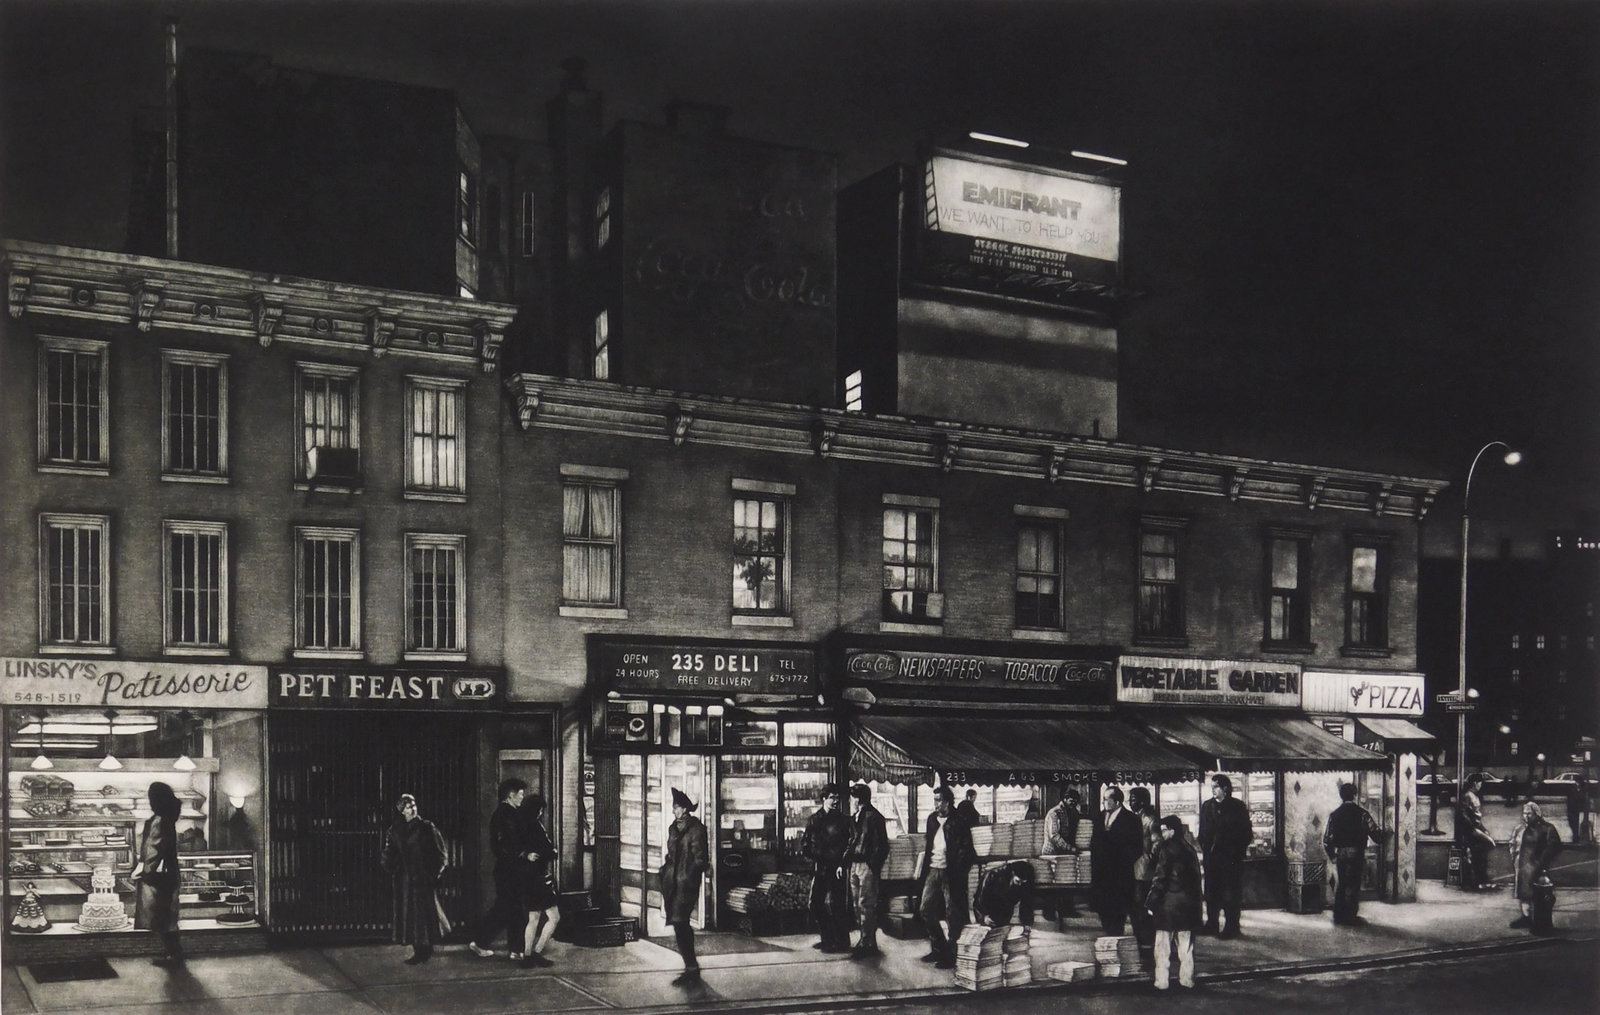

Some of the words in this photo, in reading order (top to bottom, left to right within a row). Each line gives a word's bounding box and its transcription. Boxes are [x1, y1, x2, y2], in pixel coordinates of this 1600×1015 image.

[962, 181, 1082, 220] EMIGRANT
[939, 206, 964, 223] WE
[967, 210, 1007, 234] WANT
[1015, 217, 1032, 235] TO
[1039, 223, 1074, 241] HELP
[623, 653, 649, 665] OPEN
[671, 653, 704, 671] 235
[714, 654, 760, 673] DELI
[779, 659, 796, 670] TEL
[5, 660, 97, 681] LINSKY'S
[615, 668, 626, 678] 24
[629, 669, 660, 679] HOURS
[769, 674, 809, 683] 675-1772
[899, 657, 985, 680] NEWSPAPERS
[1005, 660, 1058, 683] TOBACCO
[1121, 666, 1219, 690] VEGETABLE
[1228, 669, 1299, 694] GARDEN
[97, 671, 254, 704] Patisserie
[278, 673, 336, 698] PET
[349, 675, 445, 700] FEAST
[677, 675, 699, 685] FREE
[707, 676, 752, 687] DELIVERY
[14, 692, 82, 704] 548-1519
[1369, 685, 1423, 710] PIZZA
[947, 772, 966, 782] 233
[1053, 772, 1098, 782] SMOKE
[1116, 771, 1153, 781] SHOP
